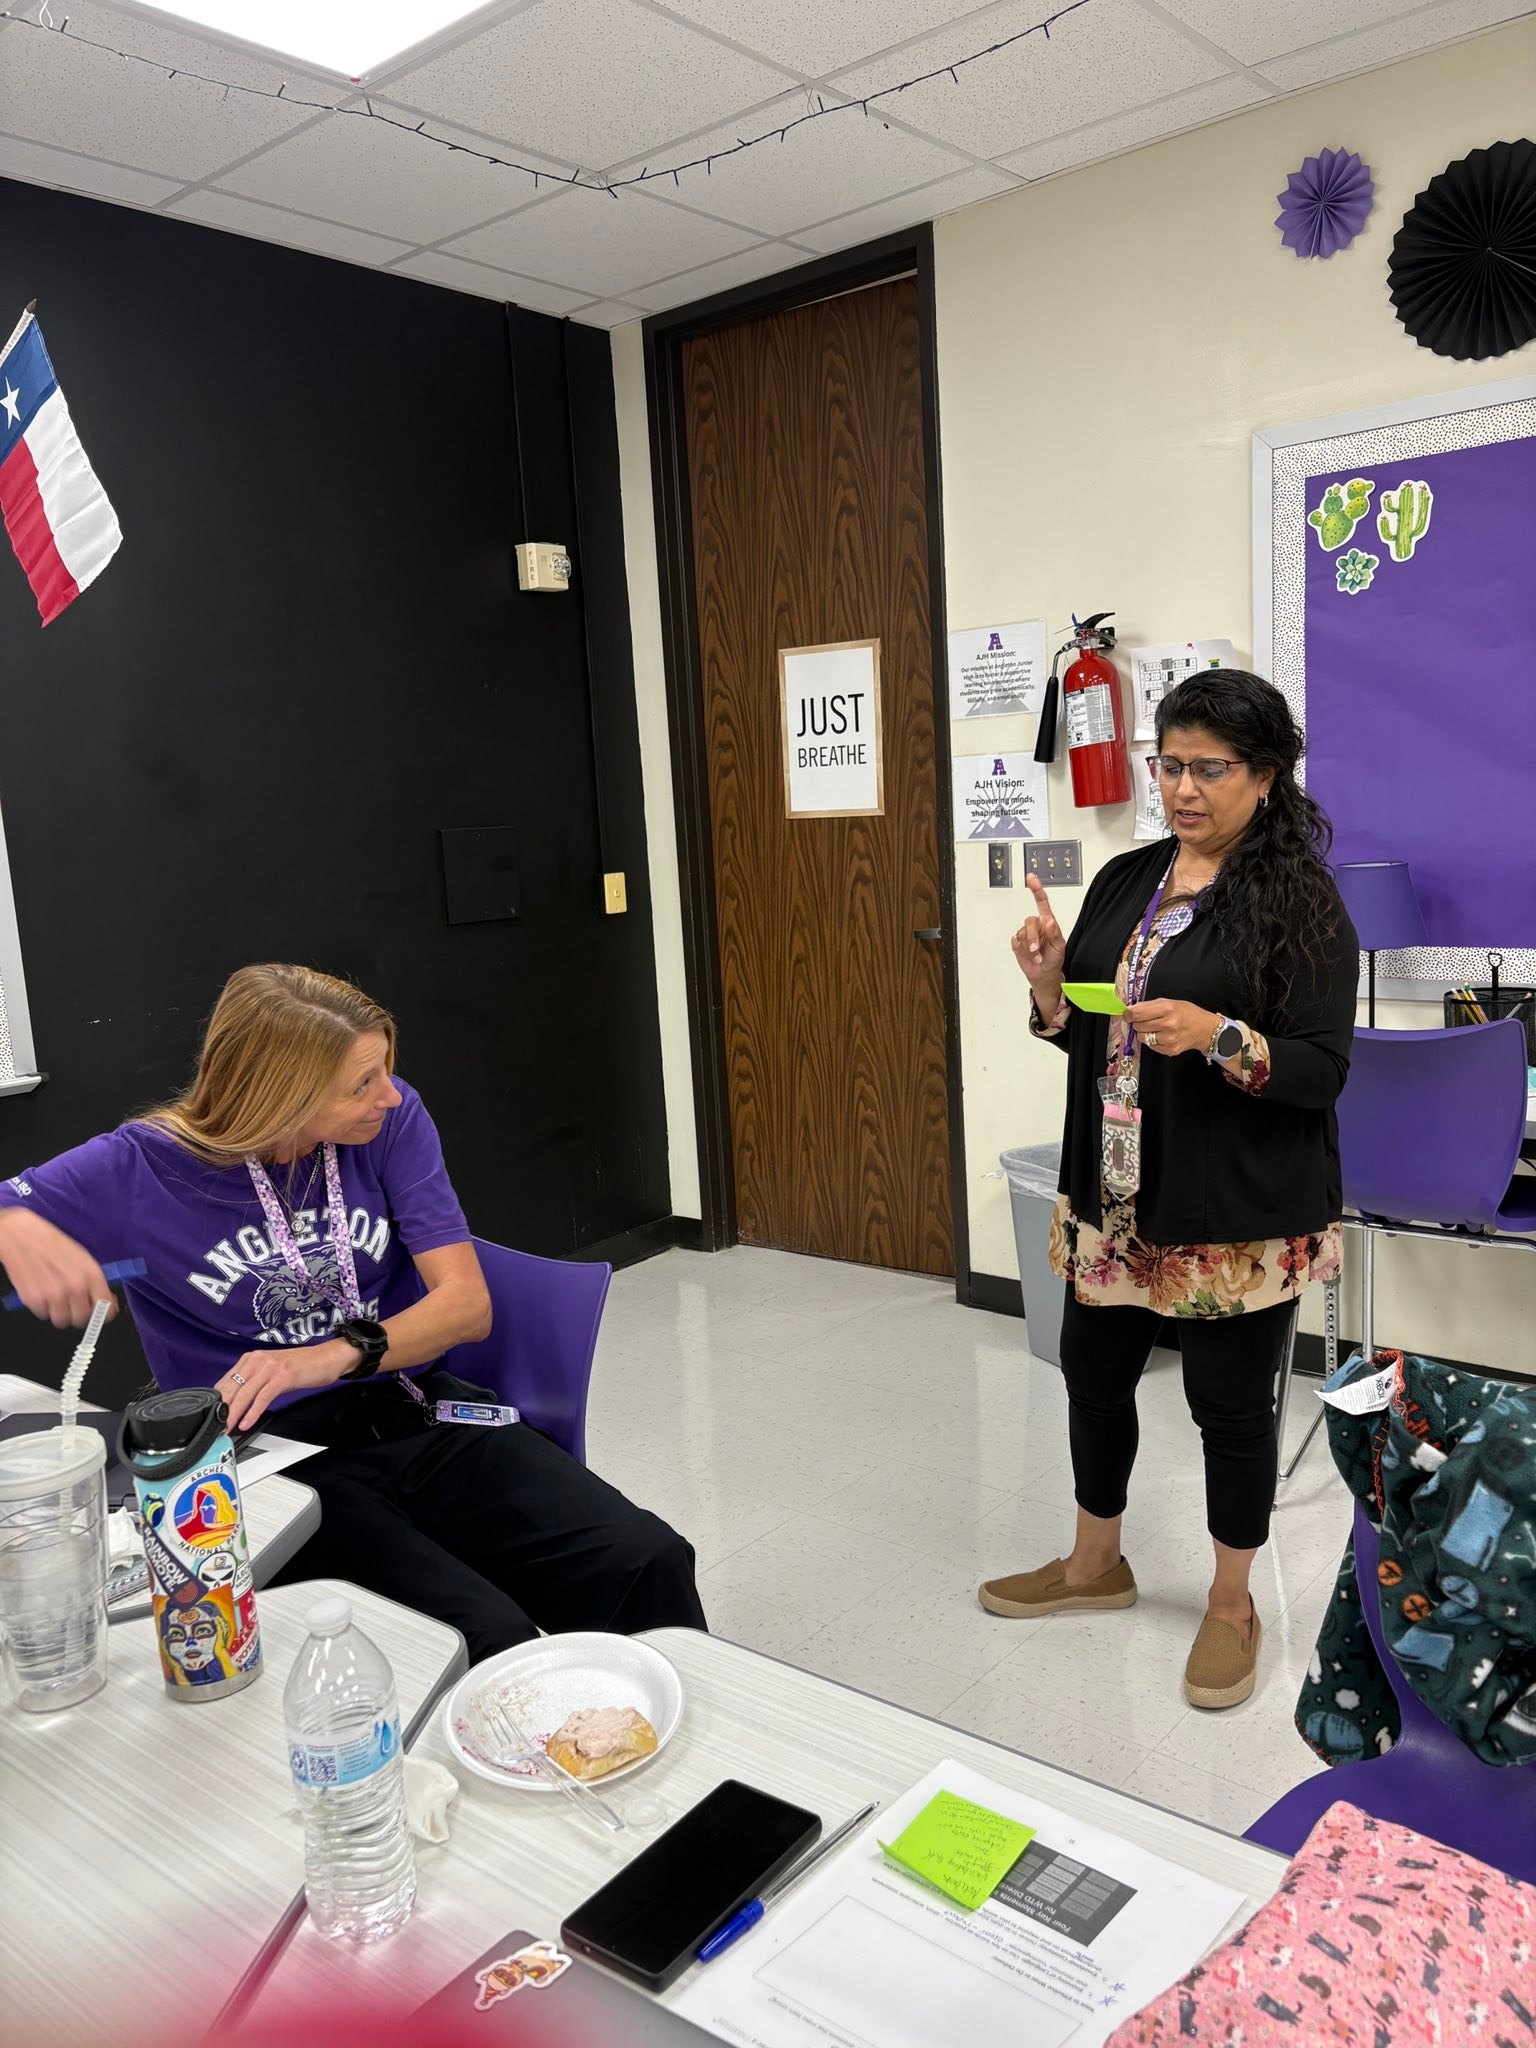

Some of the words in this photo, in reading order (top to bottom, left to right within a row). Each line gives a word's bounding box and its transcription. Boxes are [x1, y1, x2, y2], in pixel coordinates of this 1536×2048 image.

[528, 550, 536, 581] FIRE
[988, 632, 1003, 651] A
[976, 653, 989, 661] AJH
[990, 650, 1016, 659] Mission:
[797, 693, 864, 738] JUST
[798, 743, 867, 769] BREATHE
[992, 758, 1007, 776] A
[975, 780, 992, 789] AJH
[995, 779, 1025, 788] Vision:
[965, 797, 1009, 806] Empowering
[1011, 795, 1035, 804] minds,
[971, 809, 1000, 818] shaping
[191, 1465, 224, 1482] ARCHES
[179, 1541, 224, 1556] NATIONAL
[998, 1881, 1024, 1899] Directi
[998, 1890, 1036, 1915] Moments
[1023, 1893, 1044, 1909] WTD
[1042, 1903, 1057, 1915] for
[1035, 1910, 1052, 1923] Key
[1050, 1918, 1071, 1933] Four
